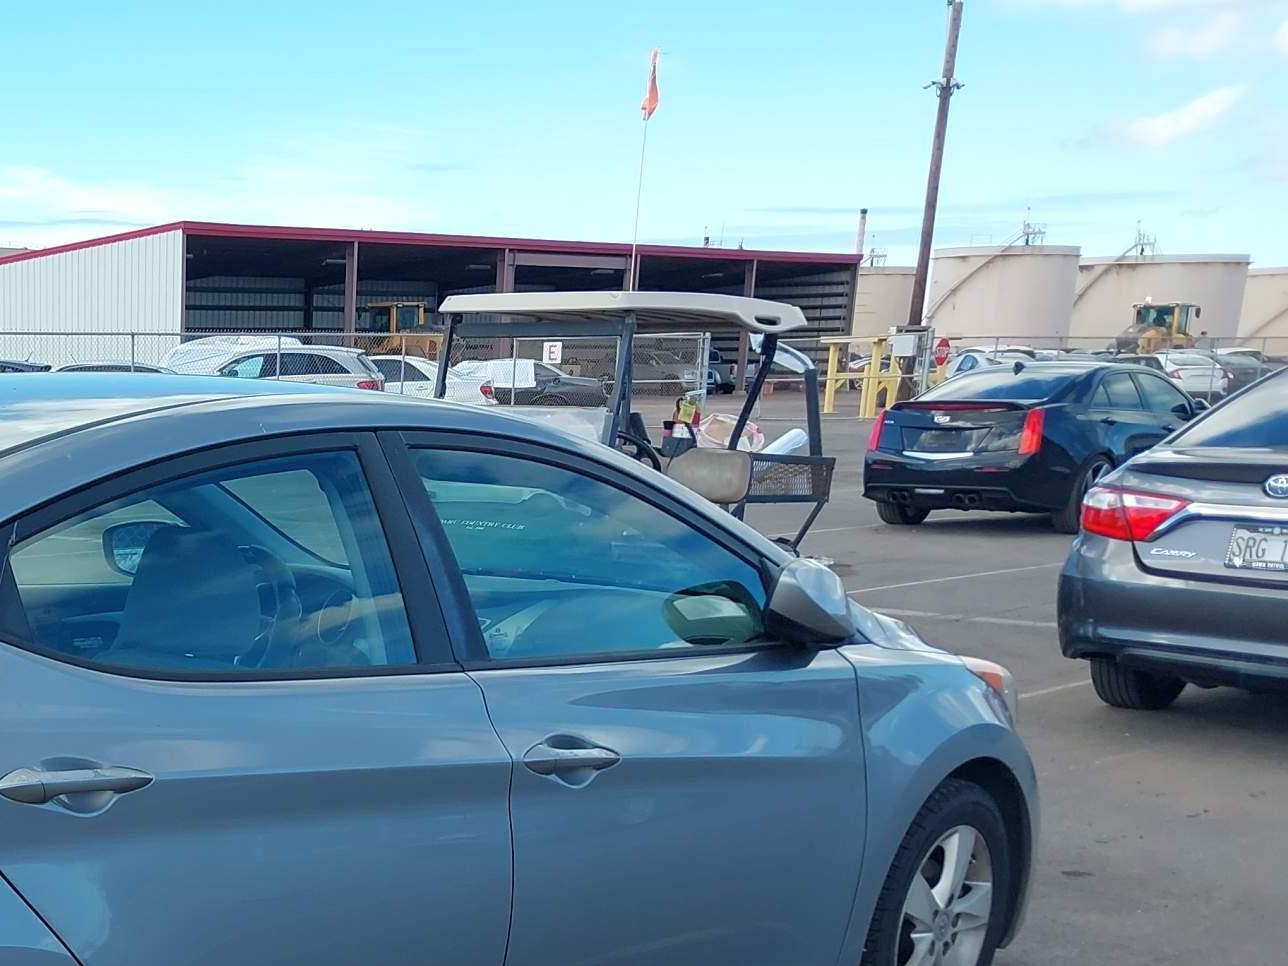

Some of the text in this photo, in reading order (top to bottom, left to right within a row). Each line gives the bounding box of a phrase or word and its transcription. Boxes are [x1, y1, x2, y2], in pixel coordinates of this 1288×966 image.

[548, 344, 558, 361] E
[1150, 547, 1197, 558] CAMRY
[1232, 536, 1268, 562] SRG
